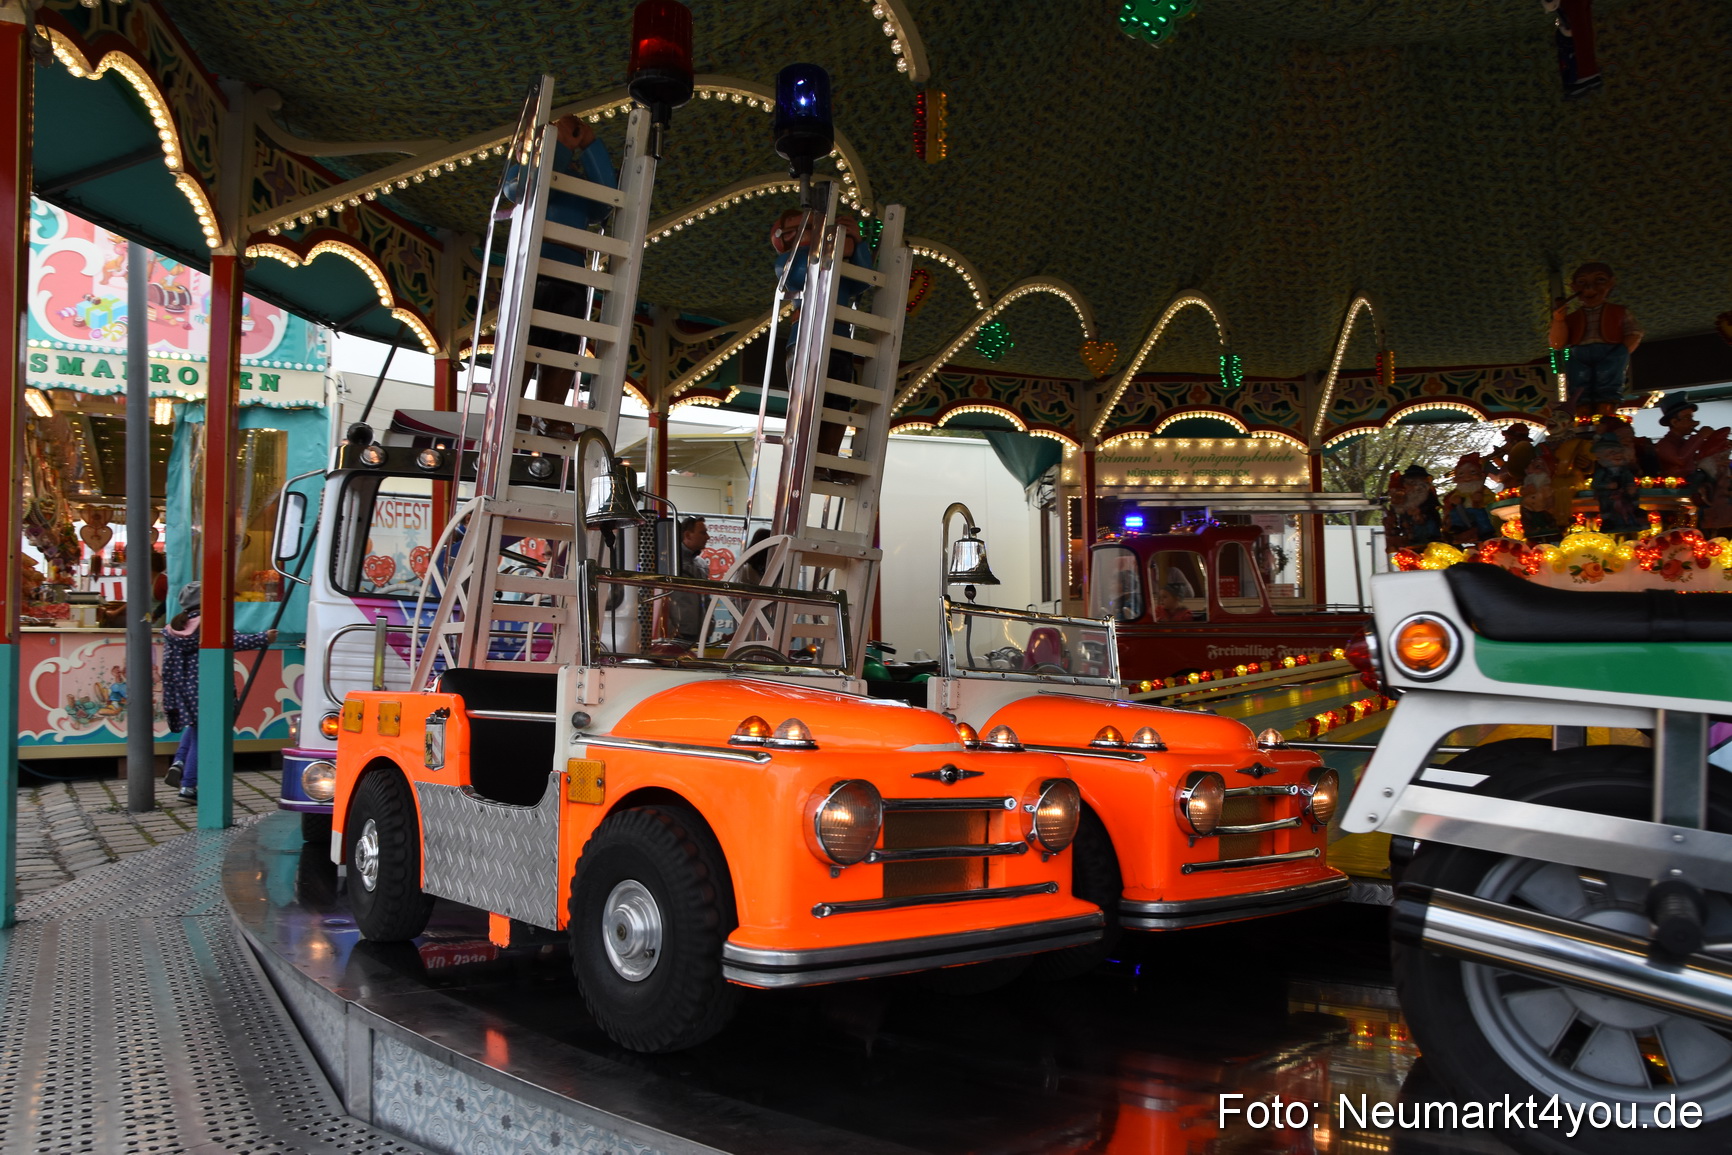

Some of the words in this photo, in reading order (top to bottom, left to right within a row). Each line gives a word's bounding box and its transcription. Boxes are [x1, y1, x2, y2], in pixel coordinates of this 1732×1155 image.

[1126, 467, 1180, 478] NÜRNBERG
[1191, 468, 1250, 478] HERSBRUCK
[1207, 643, 1276, 660] Freiwillige
